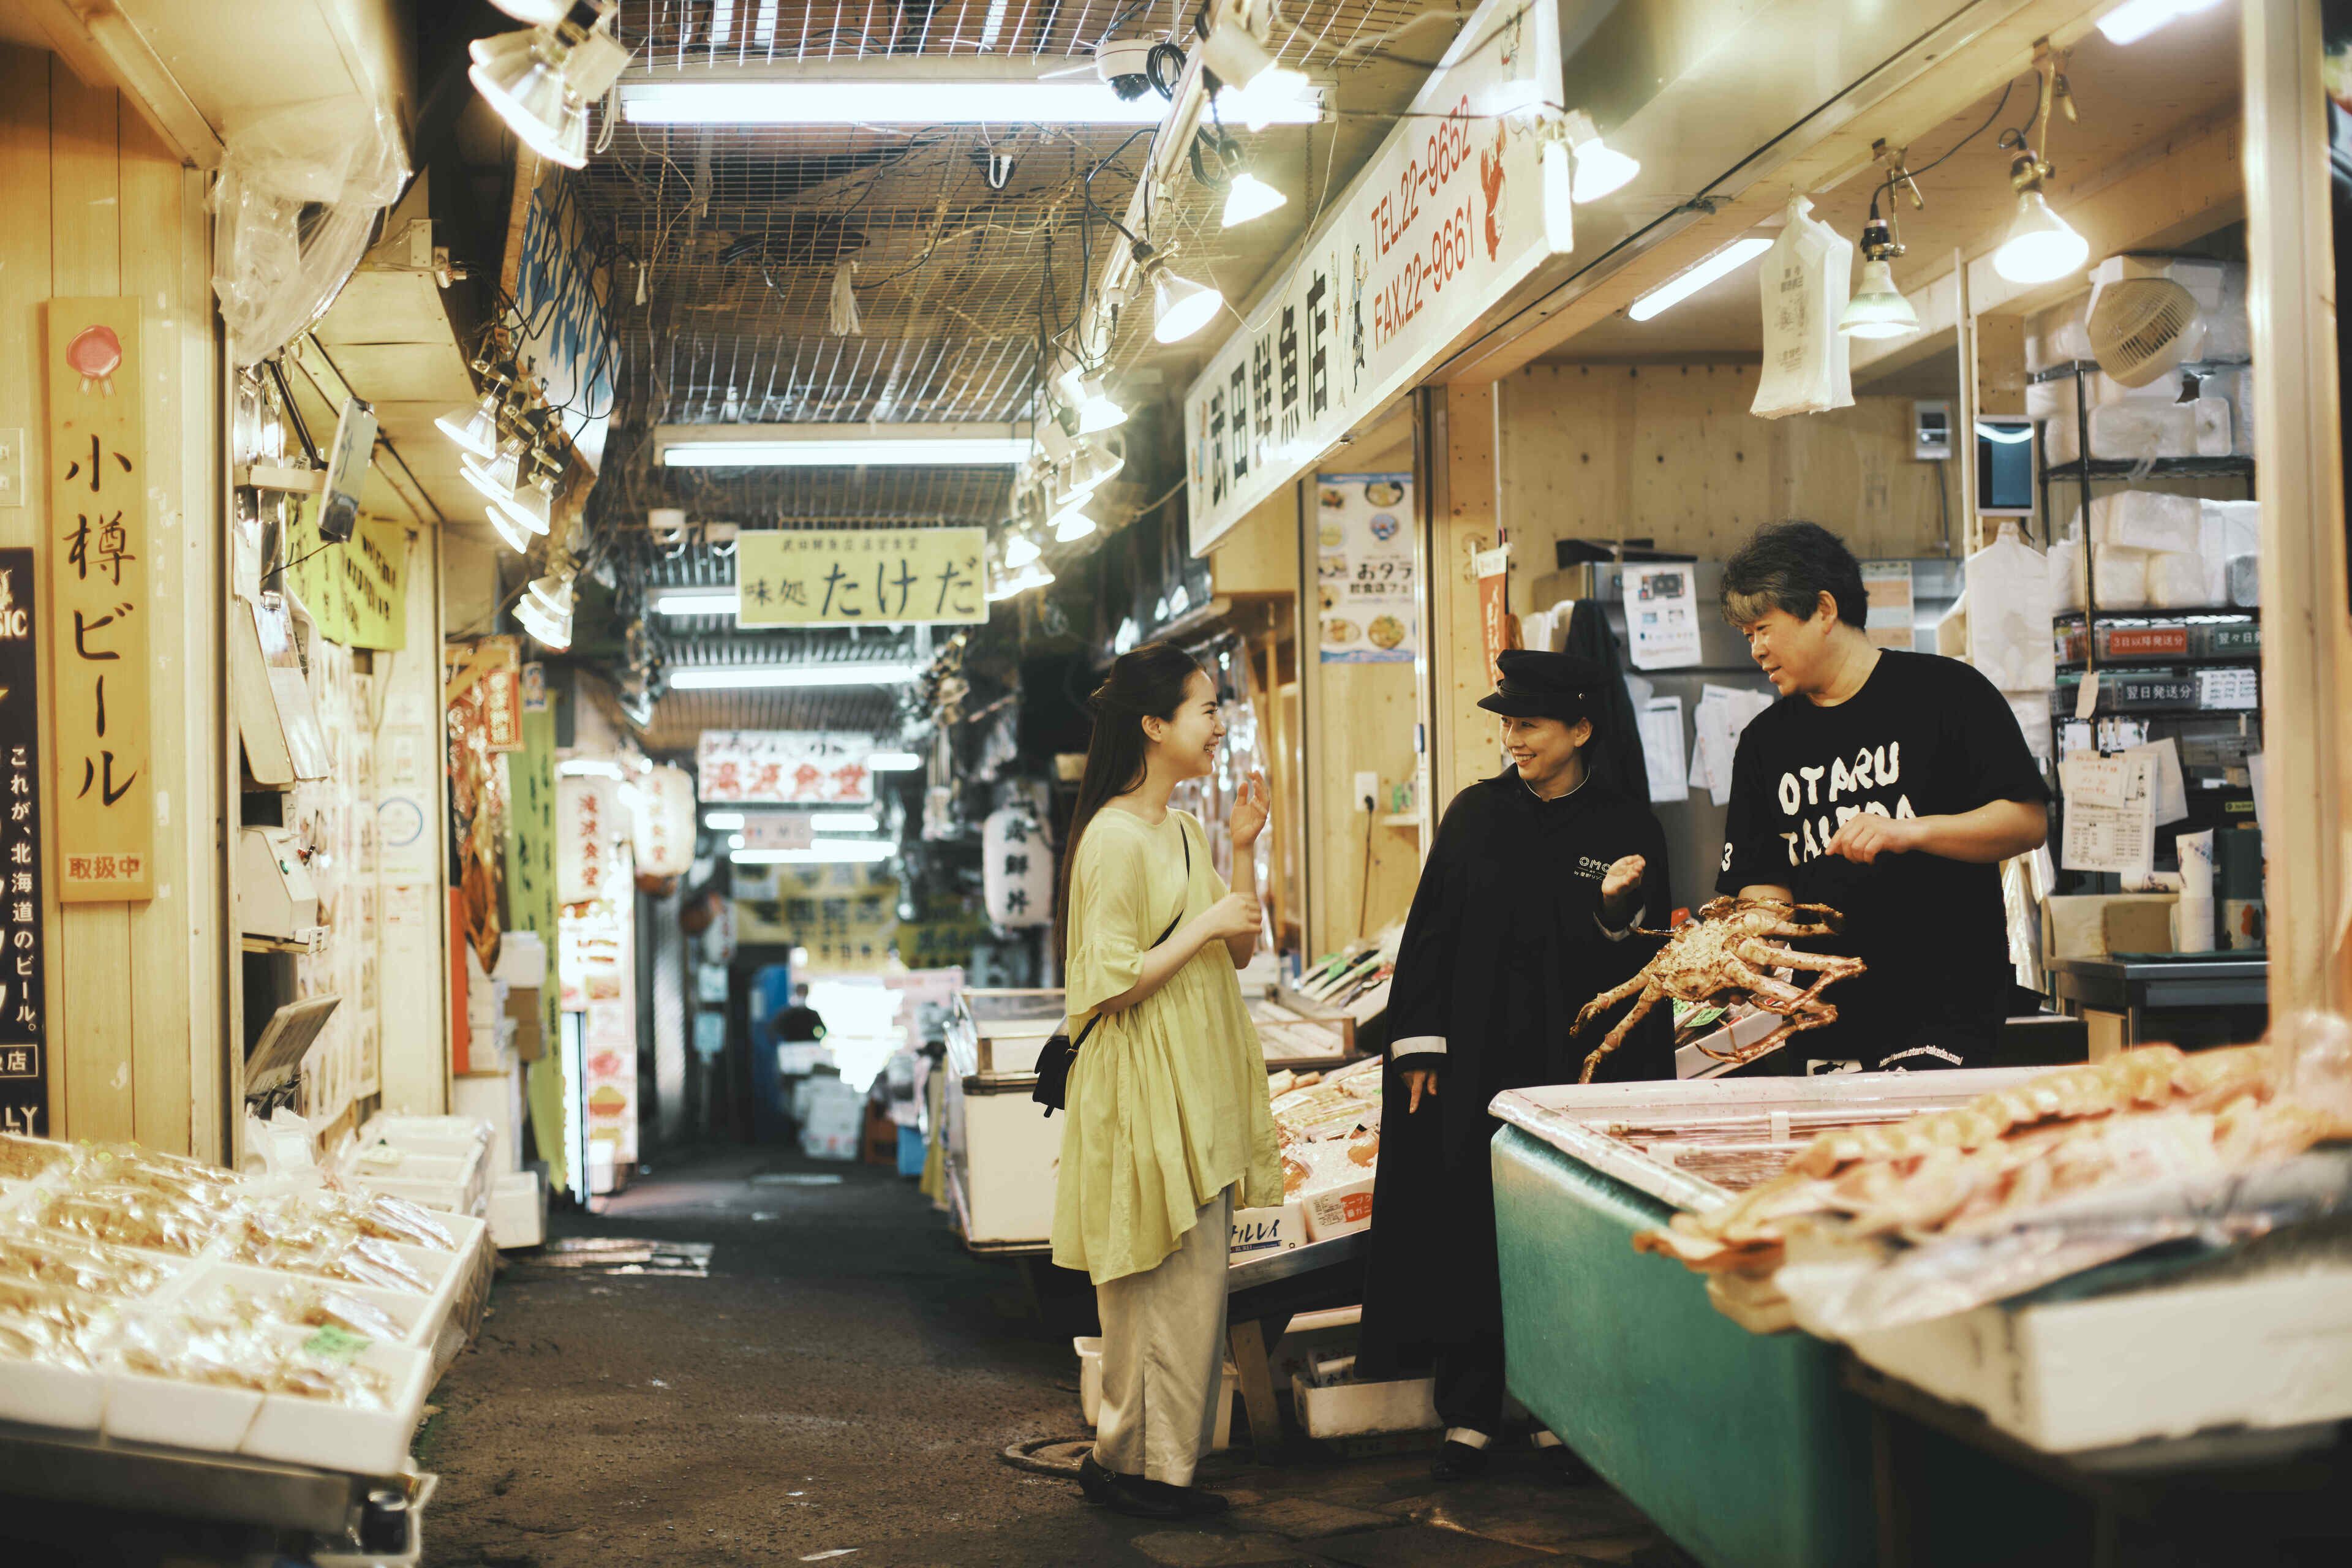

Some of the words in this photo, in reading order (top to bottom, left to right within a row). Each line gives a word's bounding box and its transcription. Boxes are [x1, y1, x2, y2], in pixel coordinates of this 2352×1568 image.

[1371, 94, 1471, 263] TEL.22-9652
[1374, 195, 1474, 352] FAX.22-9661
[62, 434, 137, 806] 小樽ビール
[822, 557, 977, 616] たけだ
[2127, 684, 2193, 700] 翌日発送分
[1778, 741, 1900, 816] OTARU
[10, 748, 36, 1032] これが、北海道のビール。
[69, 856, 140, 879] 取扱中
